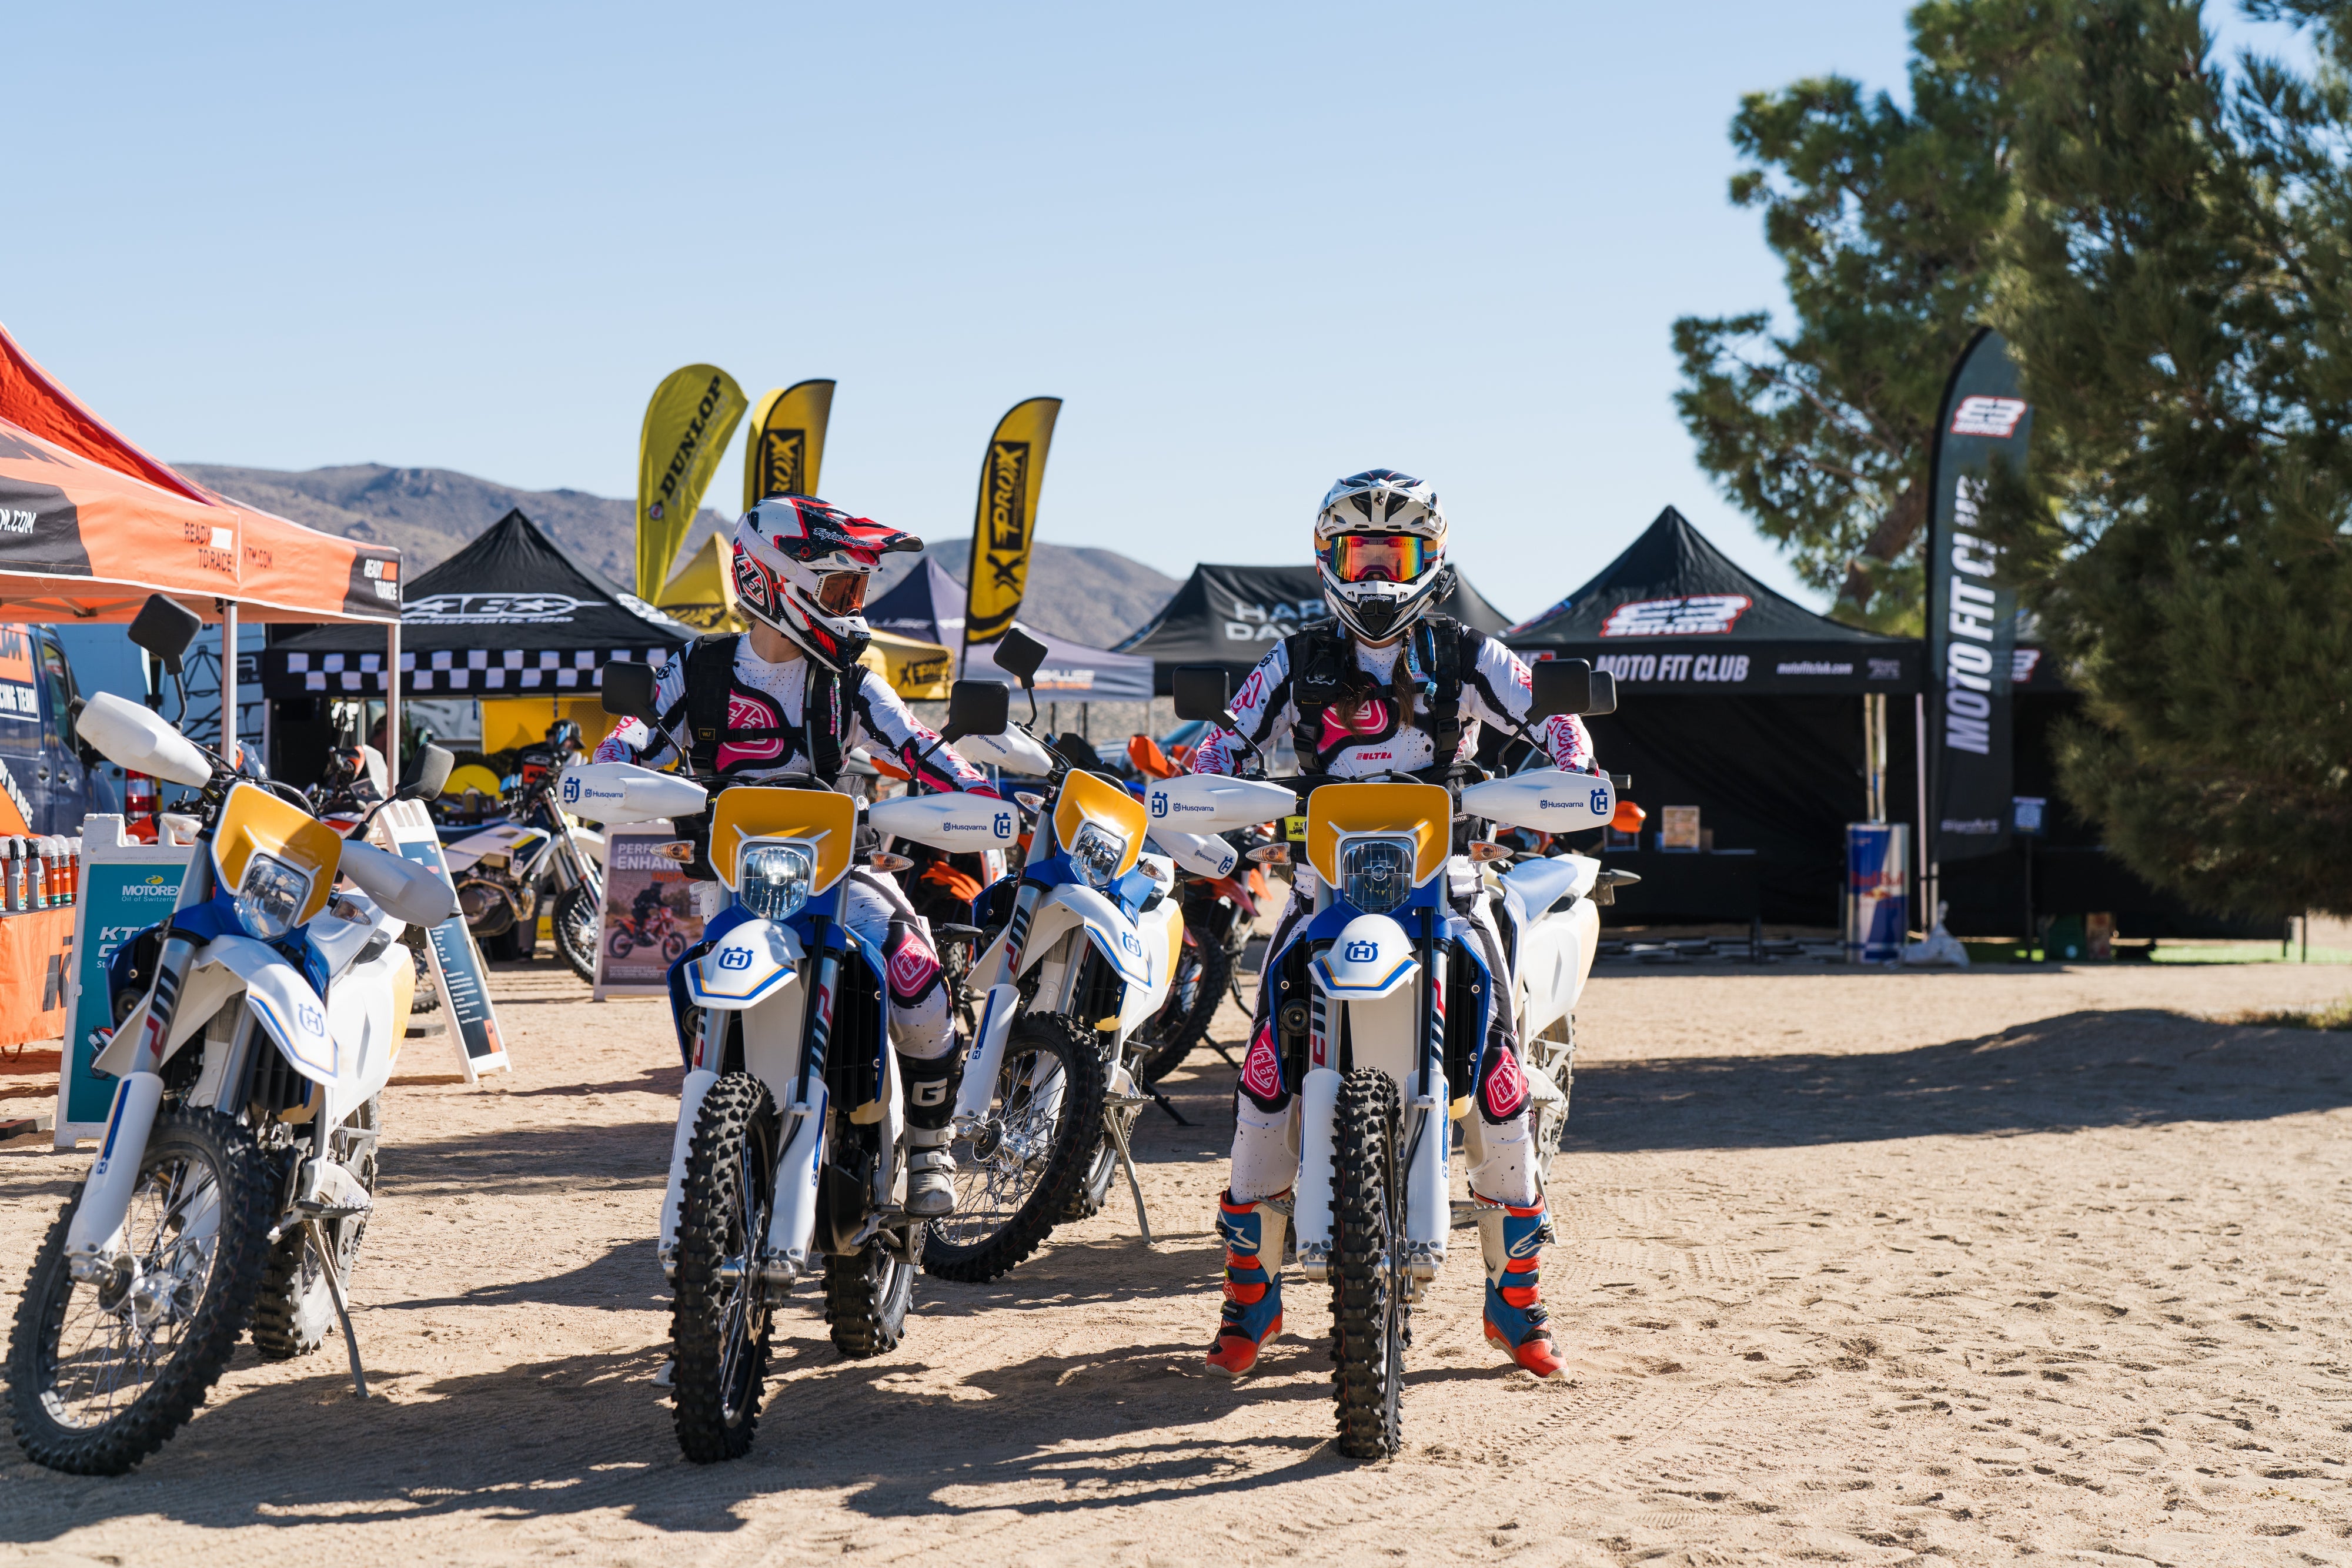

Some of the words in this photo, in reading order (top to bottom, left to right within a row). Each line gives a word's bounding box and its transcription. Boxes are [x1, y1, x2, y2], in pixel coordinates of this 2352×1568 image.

[660, 375, 721, 499] DUNLOP
[185, 522, 212, 546] READY
[813, 528, 831, 540] Troy
[828, 532, 843, 541] Lee
[842, 535, 873, 548] Designs
[198, 549, 209, 569] TO
[210, 551, 232, 572] RACE
[243, 545, 273, 570] KTM.COM
[364, 559, 385, 579] READY
[815, 577, 823, 597] OAKLEY
[1949, 574, 1996, 642] FIT
[1596, 654, 1657, 681] MOTO
[1656, 654, 1693, 681] FIT
[1692, 654, 1750, 681] CLUB
[1946, 642, 1992, 755] MOTO
[984, 736, 1007, 754] Husqvarna
[1198, 852, 1217, 864] Husqvarna
